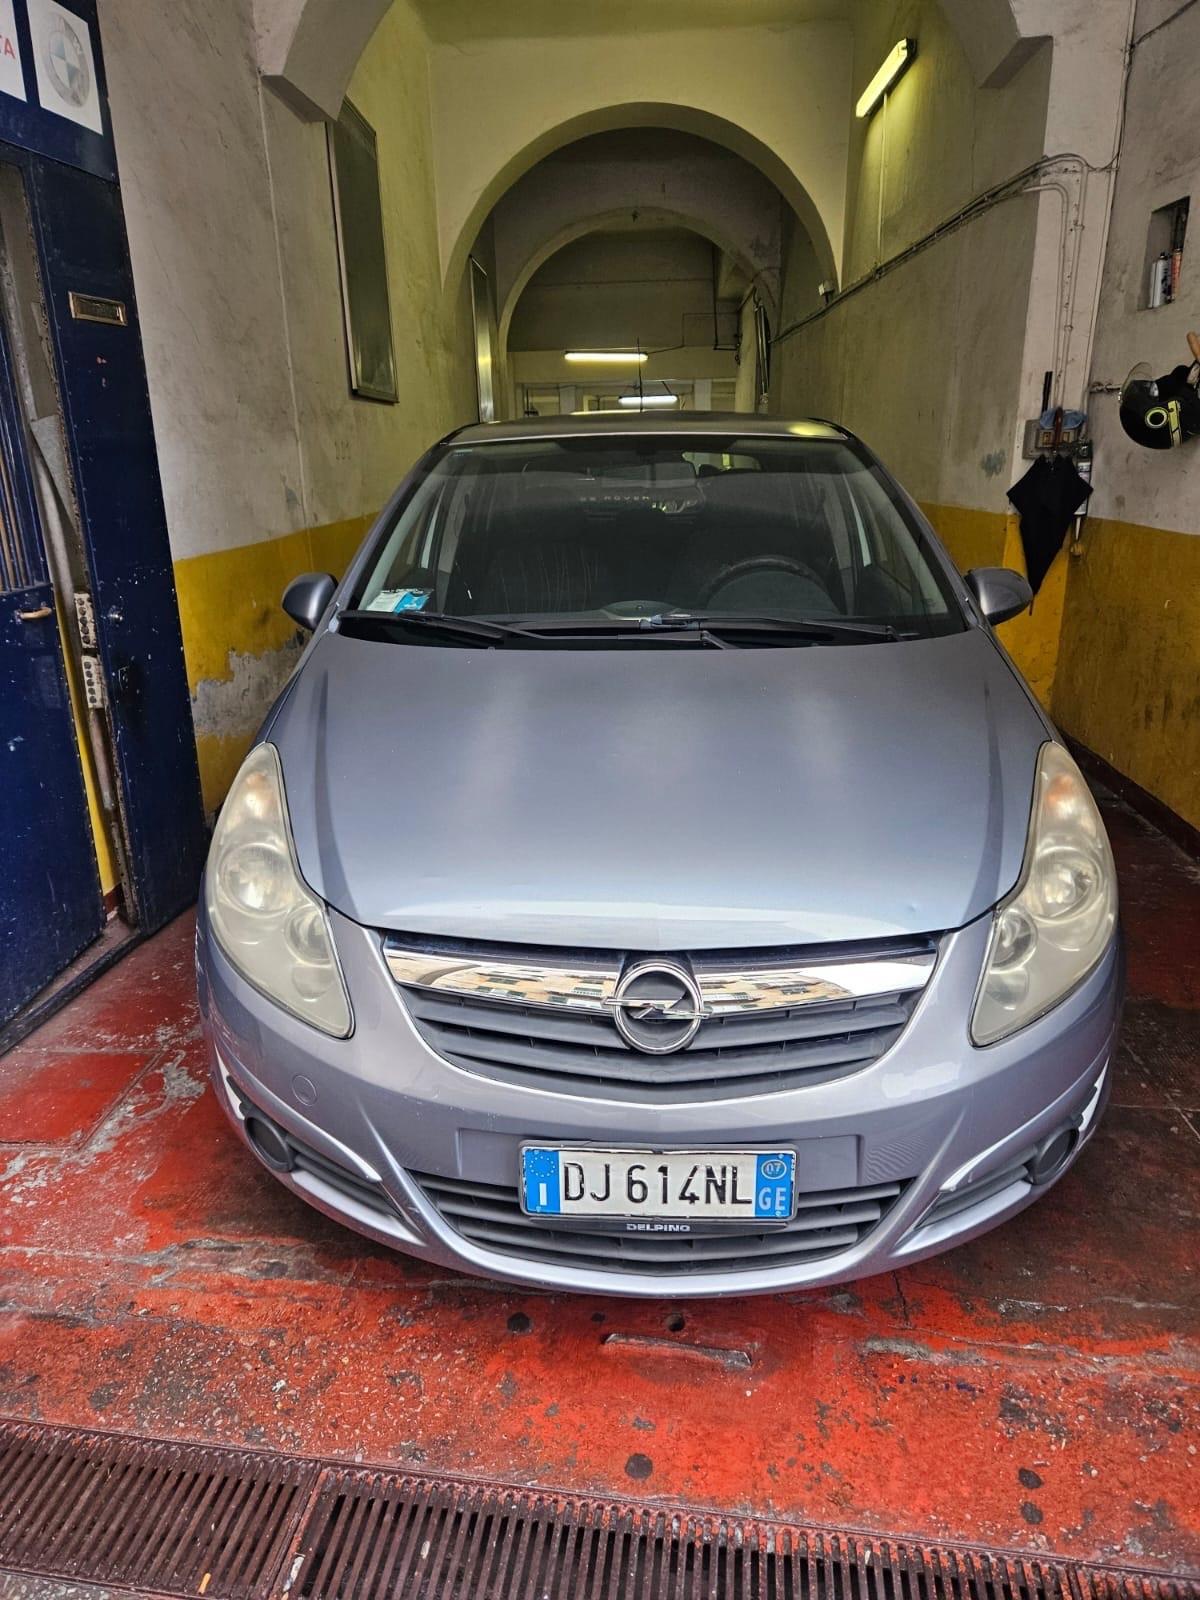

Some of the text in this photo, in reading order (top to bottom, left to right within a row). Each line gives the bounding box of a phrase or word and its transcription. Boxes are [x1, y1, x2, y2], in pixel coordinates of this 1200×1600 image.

[765, 1163, 781, 1174] 07
[758, 1187, 786, 1211] GE
[626, 1223, 690, 1232] DELPINO
